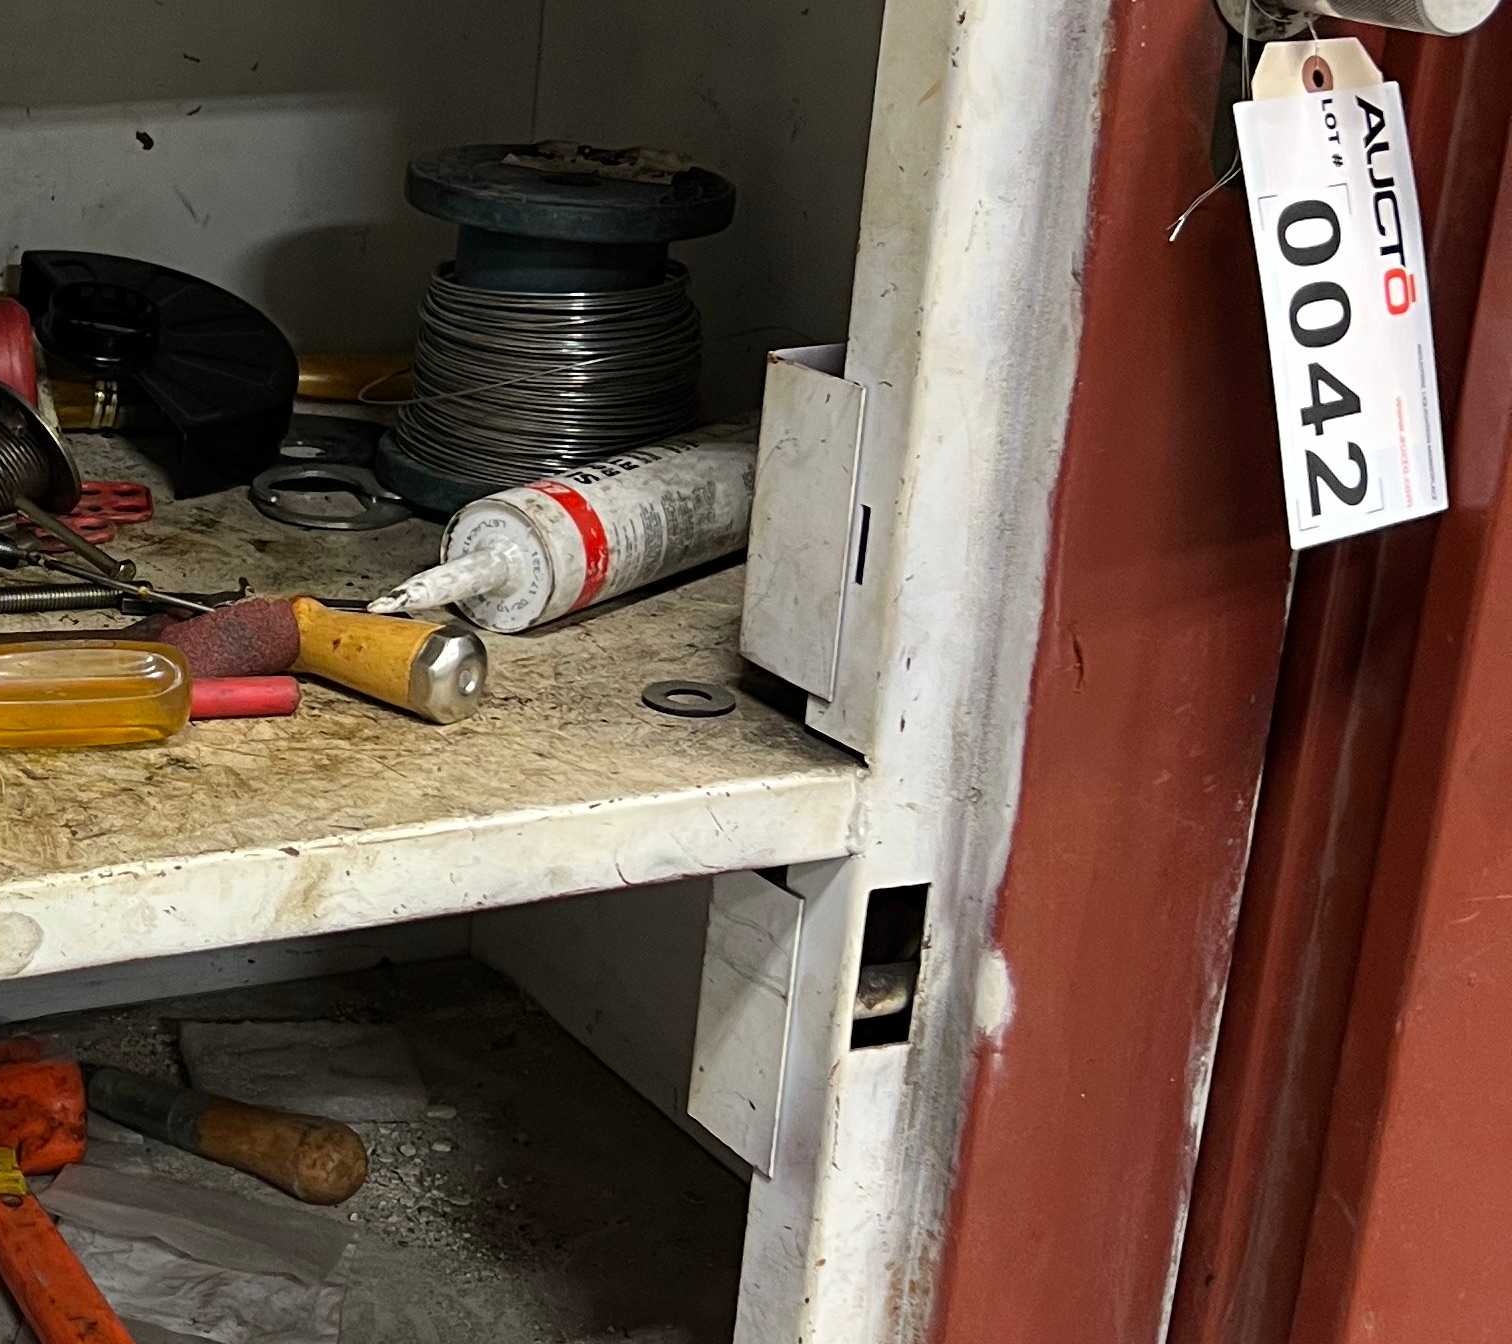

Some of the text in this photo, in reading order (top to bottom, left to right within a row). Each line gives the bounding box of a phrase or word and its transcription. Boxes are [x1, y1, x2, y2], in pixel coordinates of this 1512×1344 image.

[1321, 98, 1344, 168] LOT #
[1276, 199, 1368, 517] 0042
